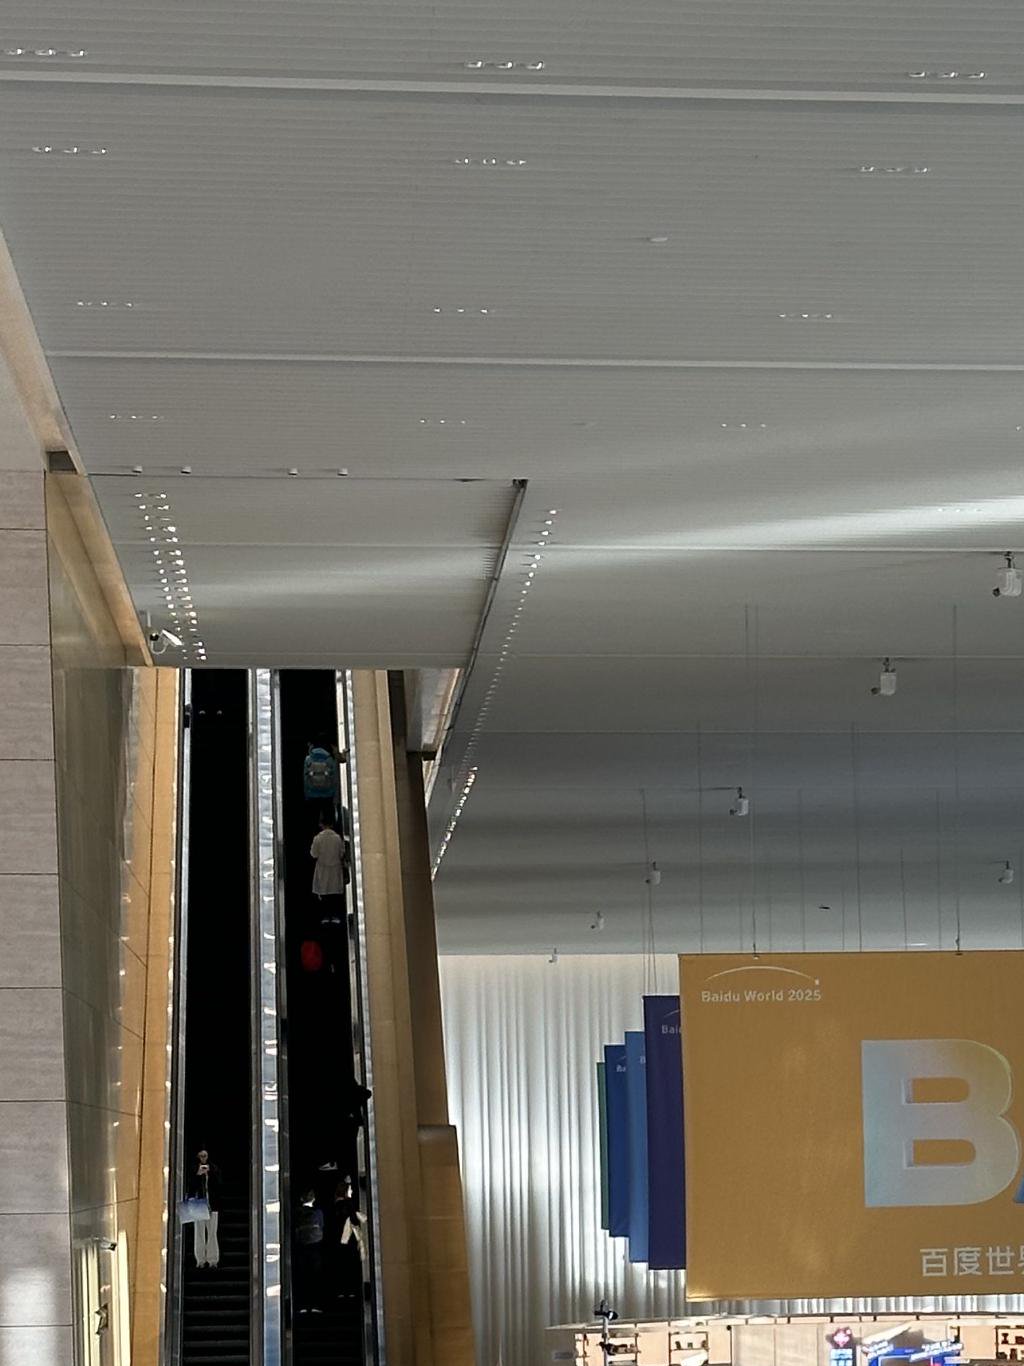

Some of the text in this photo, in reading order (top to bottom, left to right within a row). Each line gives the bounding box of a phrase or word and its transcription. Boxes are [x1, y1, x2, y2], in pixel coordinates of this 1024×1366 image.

[701, 989, 822, 1002] Baidu World 2025
